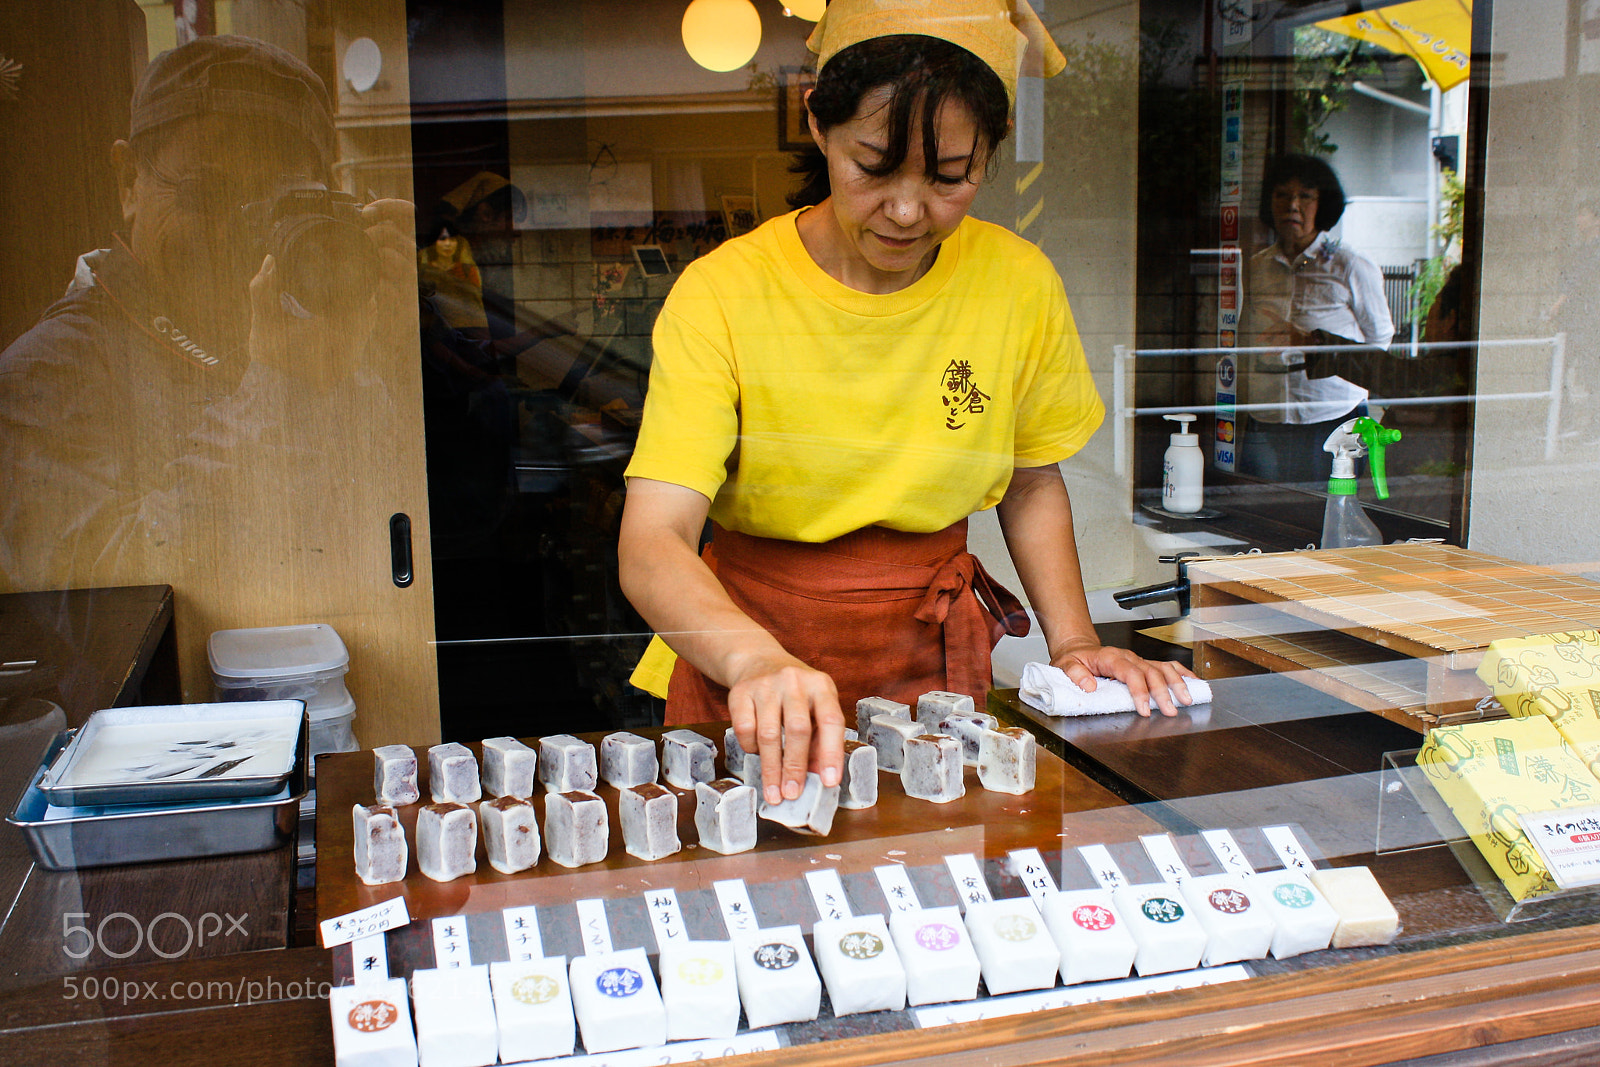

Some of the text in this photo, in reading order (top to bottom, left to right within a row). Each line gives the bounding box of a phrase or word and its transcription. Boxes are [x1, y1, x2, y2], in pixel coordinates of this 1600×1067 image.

[1222, 313, 1236, 325] VISA
[1219, 365, 1234, 378] UC
[941, 359, 991, 414] 鎌倉
[1216, 450, 1234, 464] VISA
